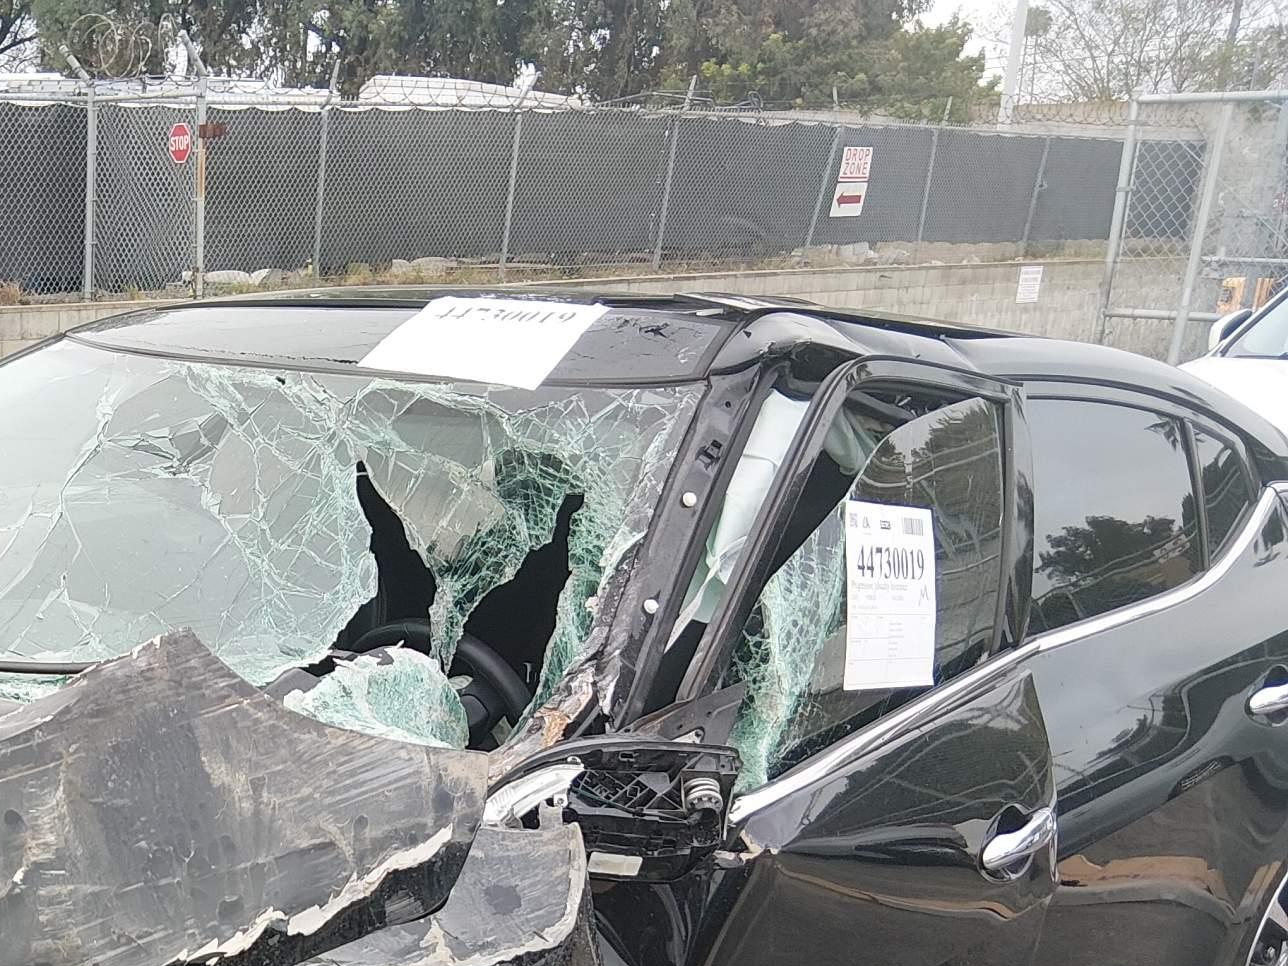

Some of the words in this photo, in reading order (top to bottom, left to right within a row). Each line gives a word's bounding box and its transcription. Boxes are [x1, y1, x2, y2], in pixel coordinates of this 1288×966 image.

[170, 134, 189, 151] STOP
[845, 148, 871, 161] DROP
[842, 162, 869, 175] ZONE
[857, 545, 924, 580] 44730019
